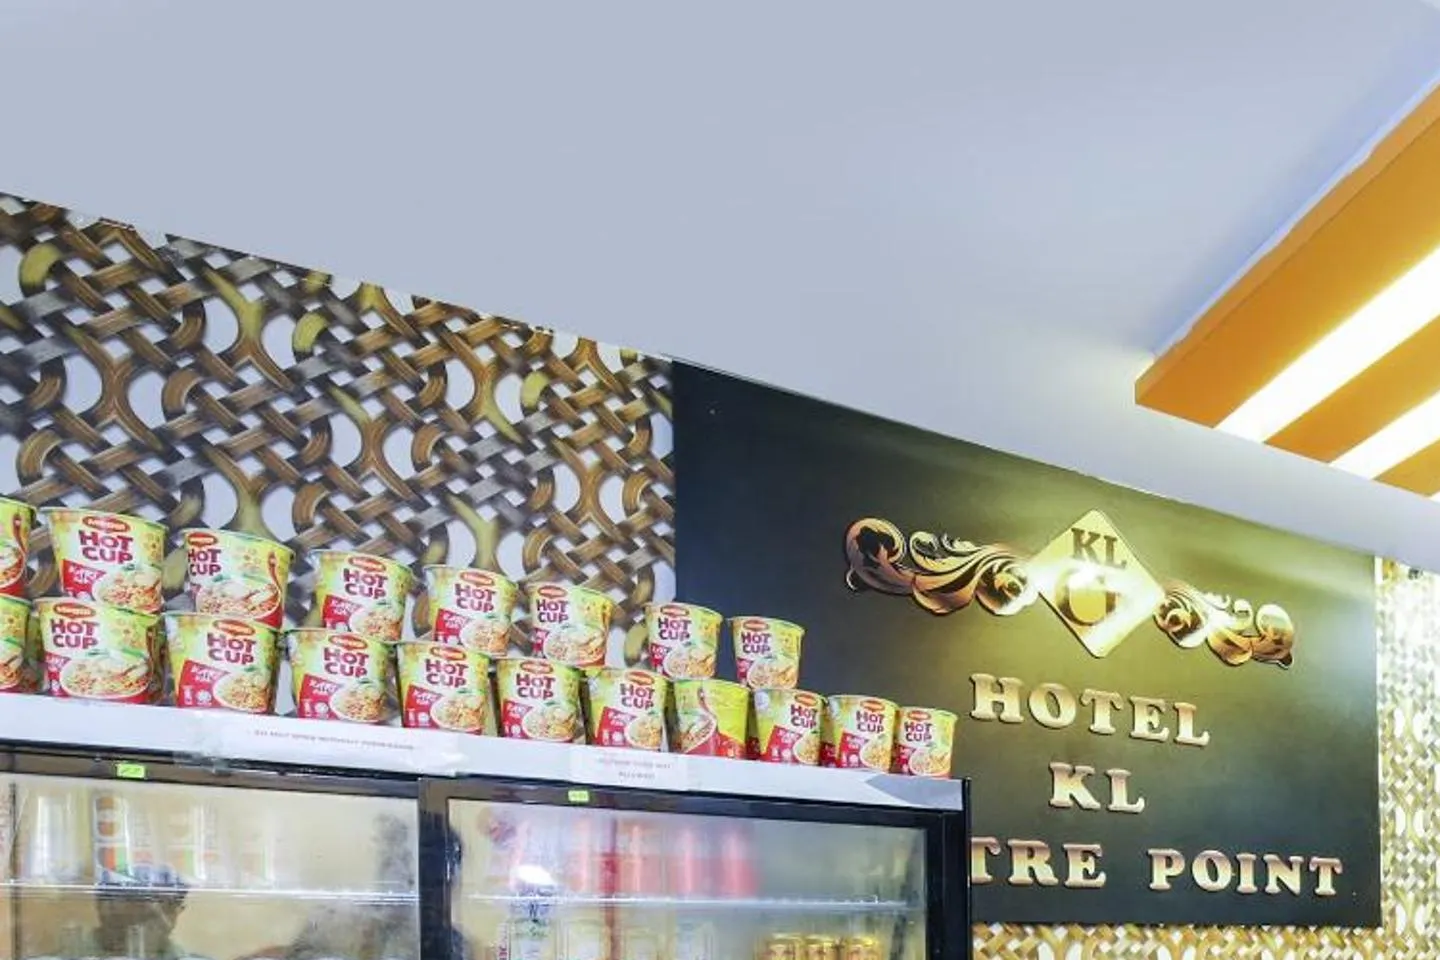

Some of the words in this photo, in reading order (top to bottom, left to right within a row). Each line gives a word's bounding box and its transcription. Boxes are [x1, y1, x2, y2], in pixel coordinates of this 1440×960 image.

[79, 530, 134, 551] HOT
[1071, 528, 1127, 569] KL
[82, 547, 134, 565] CUP
[344, 568, 388, 587] HOT
[345, 582, 386, 599] CUP
[454, 583, 497, 600] HOT
[456, 597, 495, 613] CUP
[536, 599, 569, 614] HOT
[538, 611, 569, 624] CUP
[658, 617, 692, 632] HOT
[51, 618, 99, 636] HOT
[53, 634, 98, 650] CUP
[206, 632, 256, 651] HOT
[659, 629, 690, 642] CUP
[741, 631, 771, 645] HOT
[324, 647, 369, 667] HOT
[742, 643, 770, 655] CUP
[208, 649, 255, 666] CUP
[324, 662, 368, 678] CUP
[425, 658, 468, 677] HOT
[426, 673, 467, 688] CUP
[516, 673, 556, 690] HOT
[517, 686, 554, 700] CUP
[620, 683, 655, 699] HOT
[621, 696, 655, 709] CUP
[970, 673, 1211, 747] HOTEL
[790, 704, 818, 722] HOT
[856, 710, 884, 725] HOT
[791, 716, 817, 730] CUP
[857, 722, 884, 735] CUP
[905, 721, 933, 734] HOT
[906, 732, 932, 743] CUP
[1049, 762, 1146, 813] KL
[970, 836, 1107, 888] TRE
[1147, 848, 1343, 897] POINT
